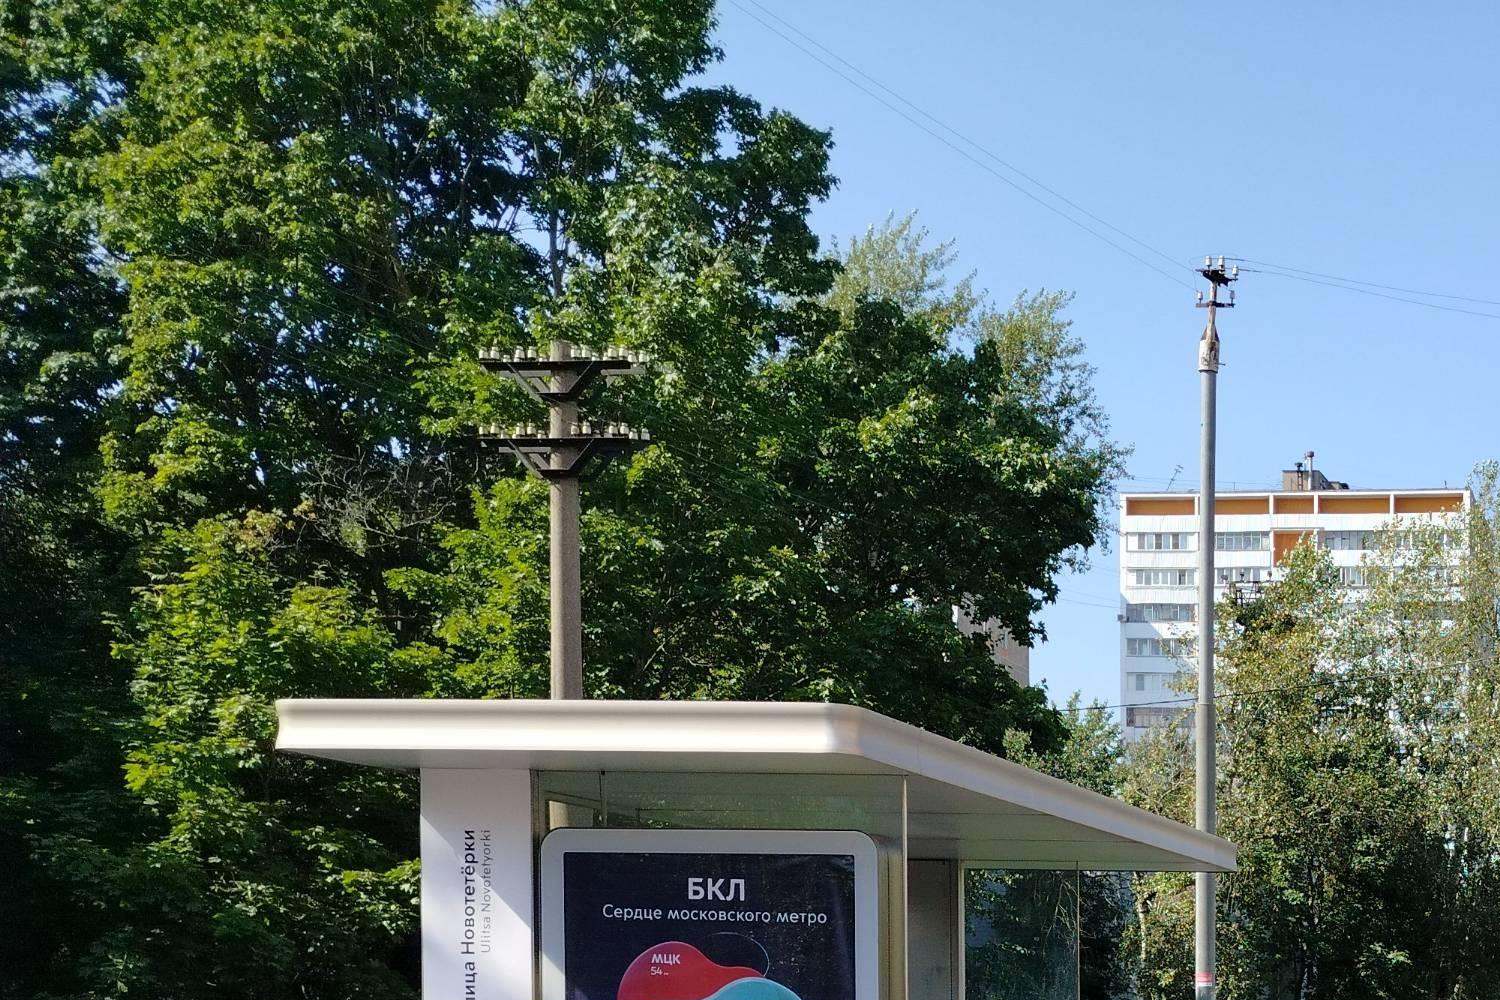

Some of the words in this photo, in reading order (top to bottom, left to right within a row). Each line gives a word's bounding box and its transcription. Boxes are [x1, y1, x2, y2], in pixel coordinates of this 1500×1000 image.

[461, 830, 478, 955] Новотетёрки
[687, 877, 746, 901] БКЛ
[602, 903, 663, 921] Сердце
[667, 908, 771, 923] московского
[776, 911, 828, 926] метро
[651, 953, 681, 966] МЦК
[650, 966, 663, 977] 54
